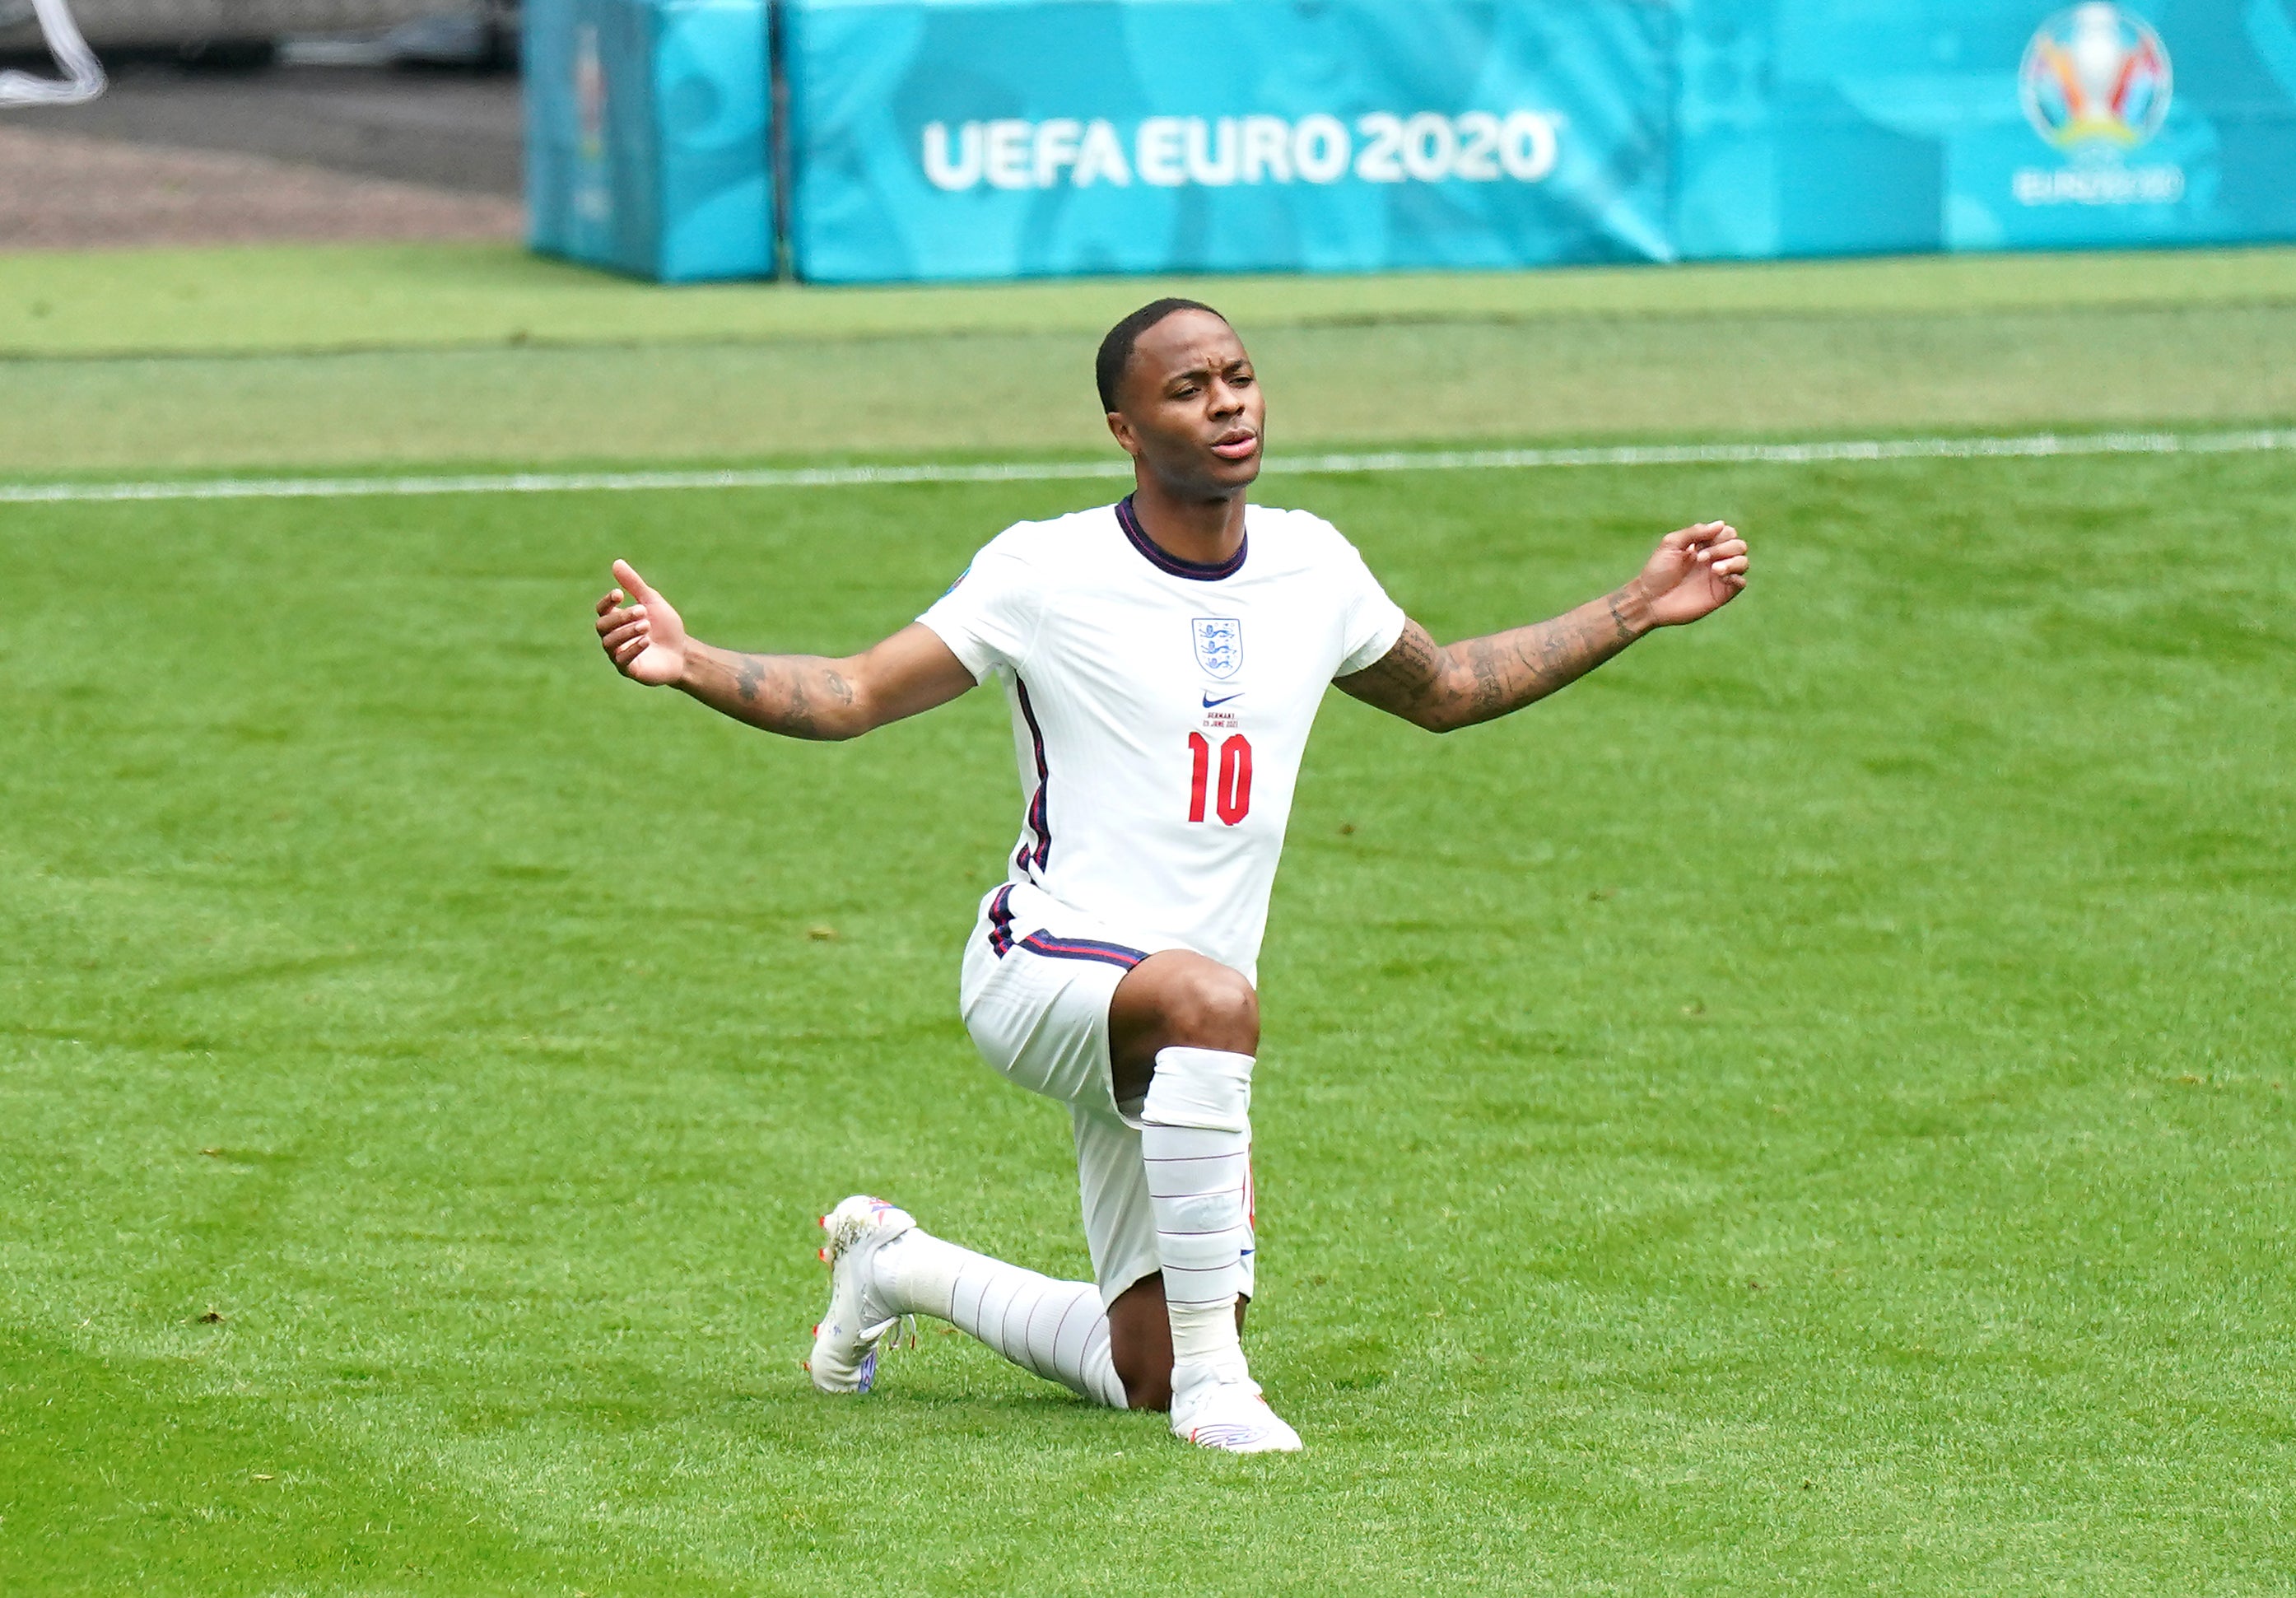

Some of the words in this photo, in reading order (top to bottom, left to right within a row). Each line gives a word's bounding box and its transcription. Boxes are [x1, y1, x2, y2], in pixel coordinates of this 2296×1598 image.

[924, 119, 1129, 189] UEFA
[1136, 114, 1350, 185] EURO
[1356, 109, 1558, 180] 2020
[1189, 732, 1252, 826] 10
